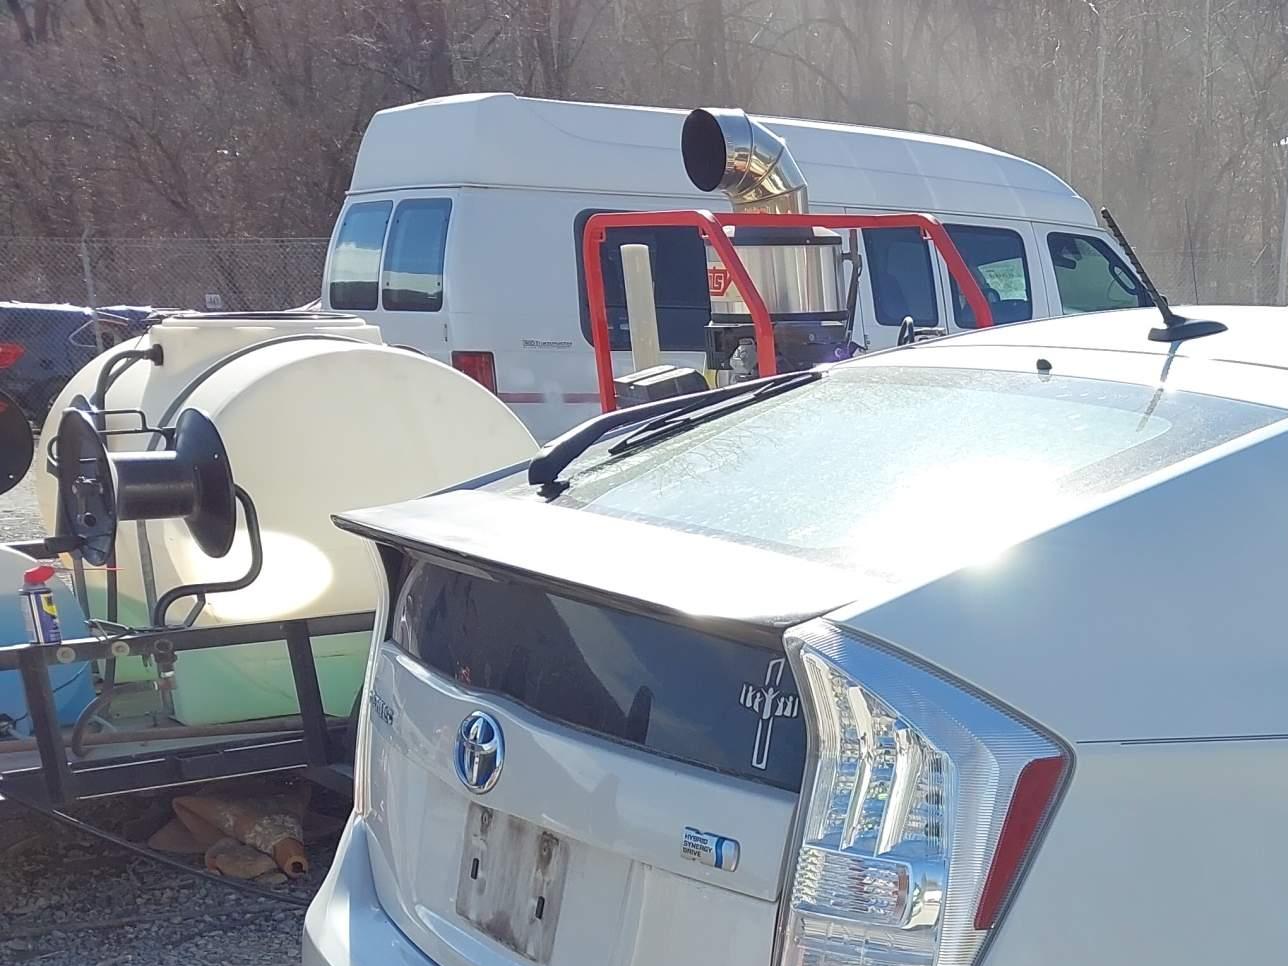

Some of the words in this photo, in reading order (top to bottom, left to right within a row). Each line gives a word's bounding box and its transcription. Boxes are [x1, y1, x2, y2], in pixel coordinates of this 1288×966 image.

[684, 833, 709, 845] HYBRID
[682, 847, 702, 858] DRIVE
[683, 840, 713, 854] SYNERGY
